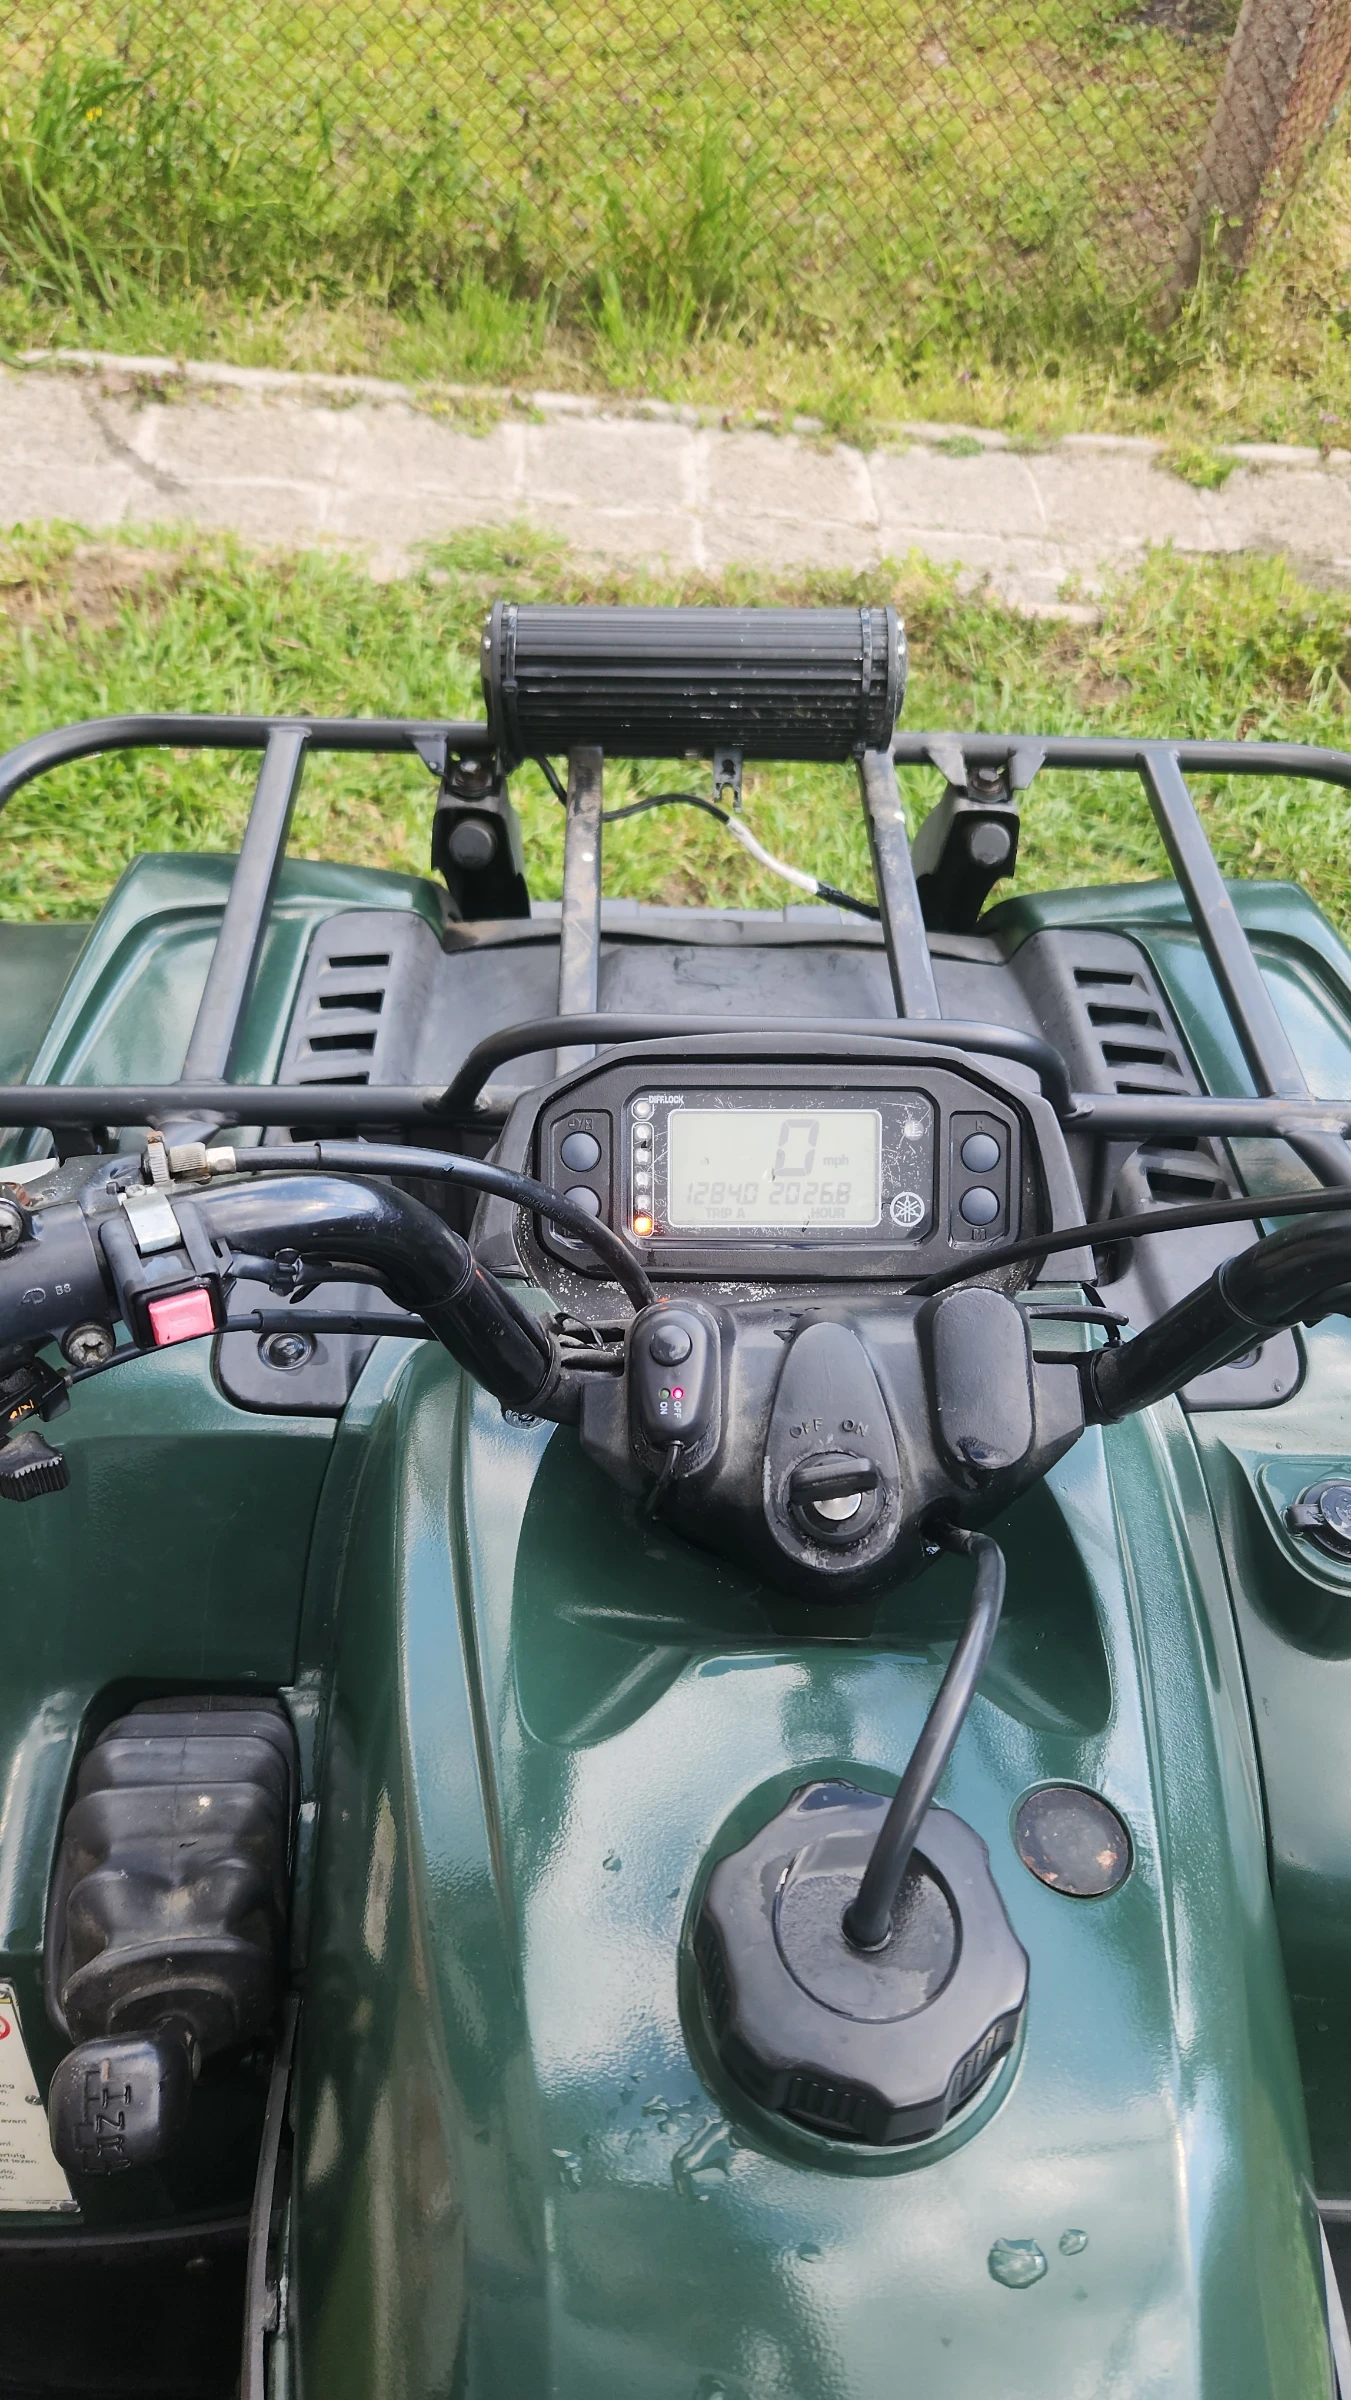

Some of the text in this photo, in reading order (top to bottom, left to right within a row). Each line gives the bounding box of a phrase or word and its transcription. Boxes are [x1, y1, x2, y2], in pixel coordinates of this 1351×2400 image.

[774, 1118, 820, 1177] 0
[822, 1154, 850, 1168] mph
[704, 1207, 747, 1219] TRIP A
[810, 1207, 846, 1219] HOUR
[971, 1228, 987, 1241] M
[659, 1401, 669, 1416] ON
[673, 1400, 682, 1419] OFF
[788, 1417, 870, 1439] OFF ON
